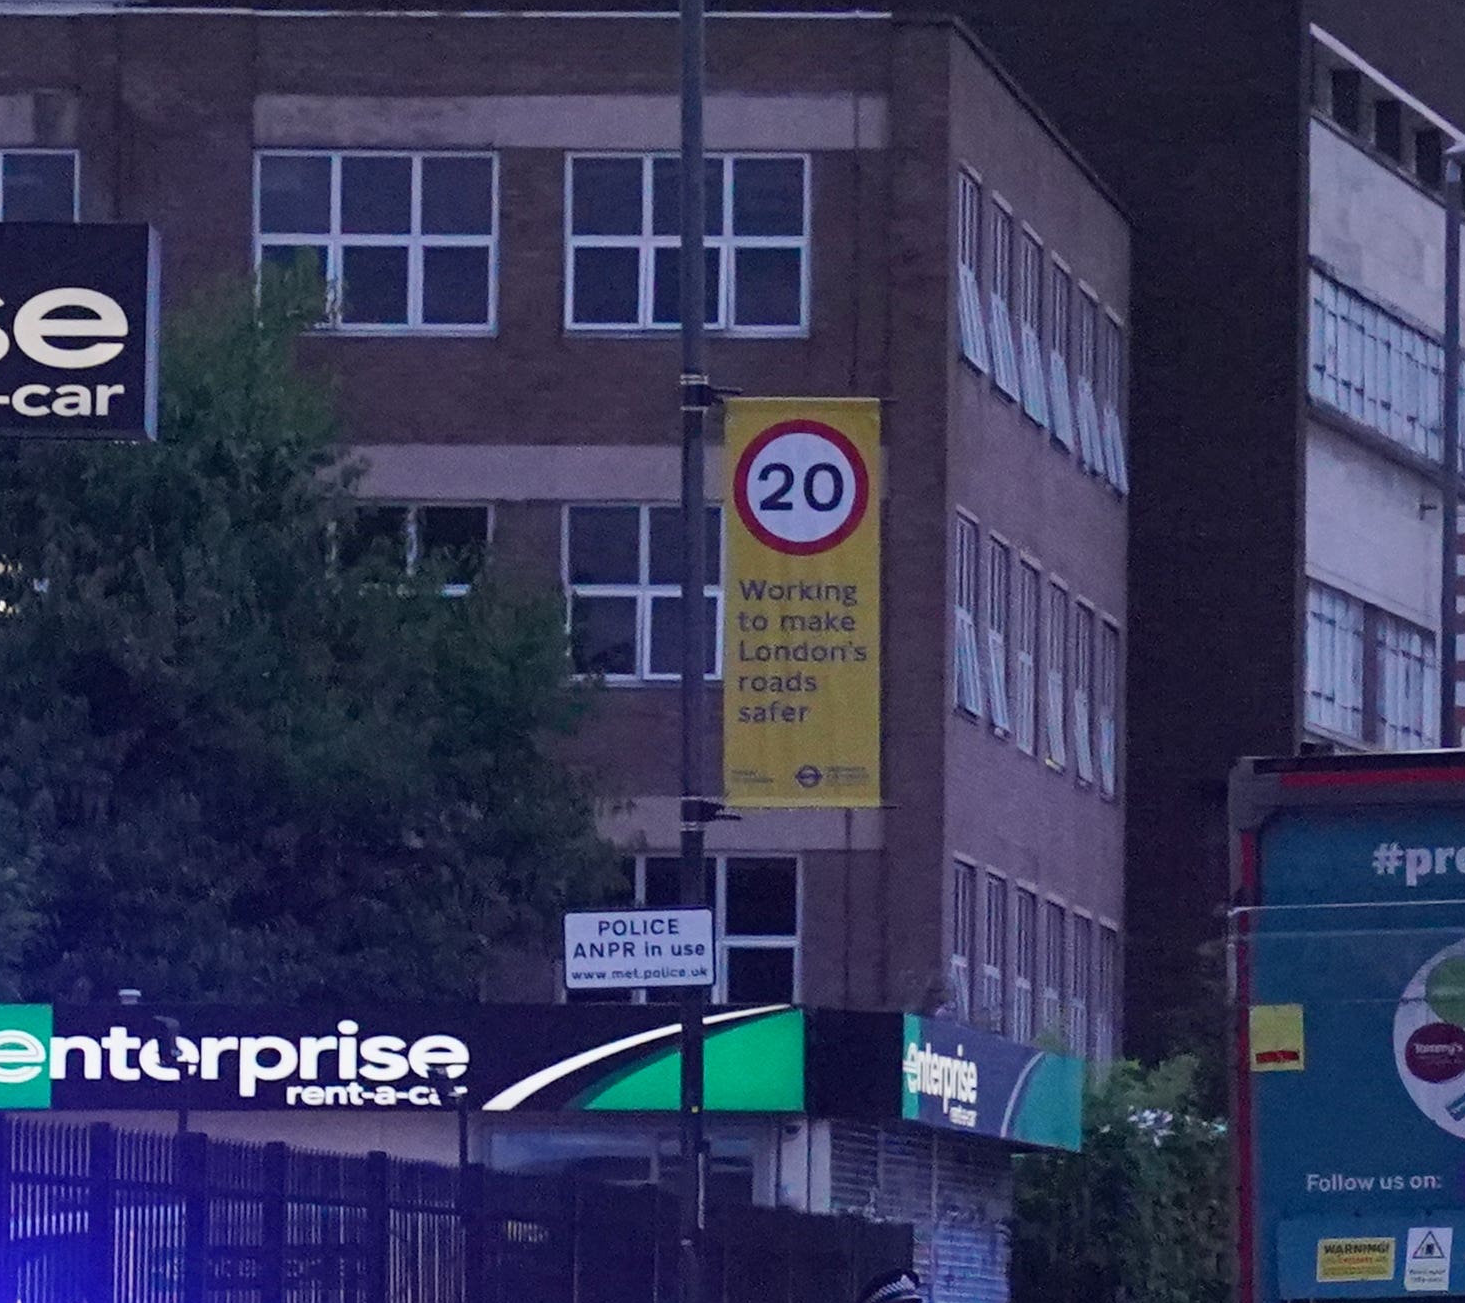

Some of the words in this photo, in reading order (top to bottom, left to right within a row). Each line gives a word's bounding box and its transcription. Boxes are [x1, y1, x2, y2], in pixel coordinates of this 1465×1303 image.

[757, 462, 845, 512] 20
[739, 579, 858, 607] Working
[739, 612, 768, 632] to
[781, 612, 856, 632] make
[740, 640, 868, 663] London's
[739, 671, 818, 693] roads
[739, 701, 811, 723] safer
[598, 918, 680, 937] POLICE
[573, 941, 636, 959] ANPR
[645, 941, 662, 957] in
[671, 943, 706, 957] use
[903, 1042, 979, 1115] enterprise
[1307, 1173, 1374, 1193] Follow
[1380, 1175, 1405, 1191] us
[1410, 1173, 1442, 1190] on:
